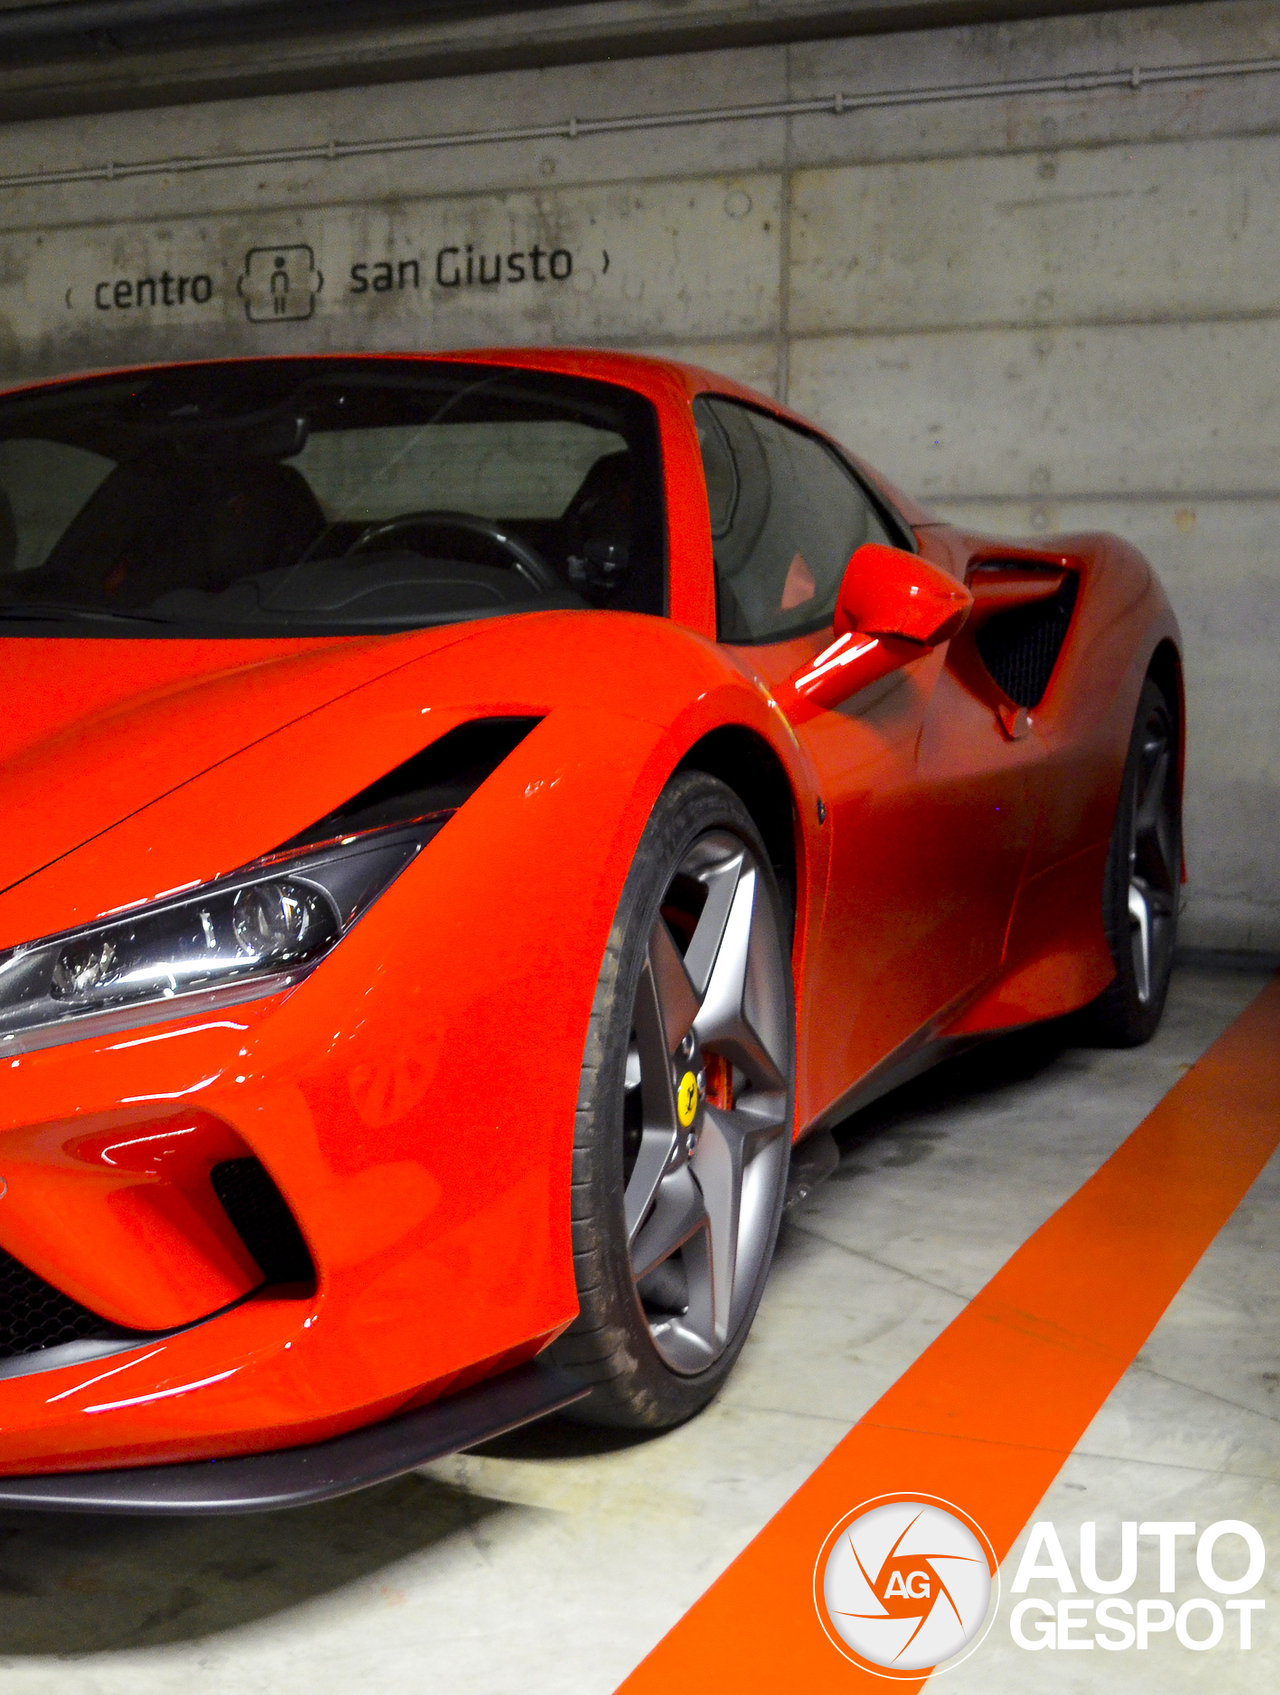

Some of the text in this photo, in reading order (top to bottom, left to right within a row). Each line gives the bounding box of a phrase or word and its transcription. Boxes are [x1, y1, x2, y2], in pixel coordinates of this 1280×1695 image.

[94, 243, 574, 311] centro san Giusto
